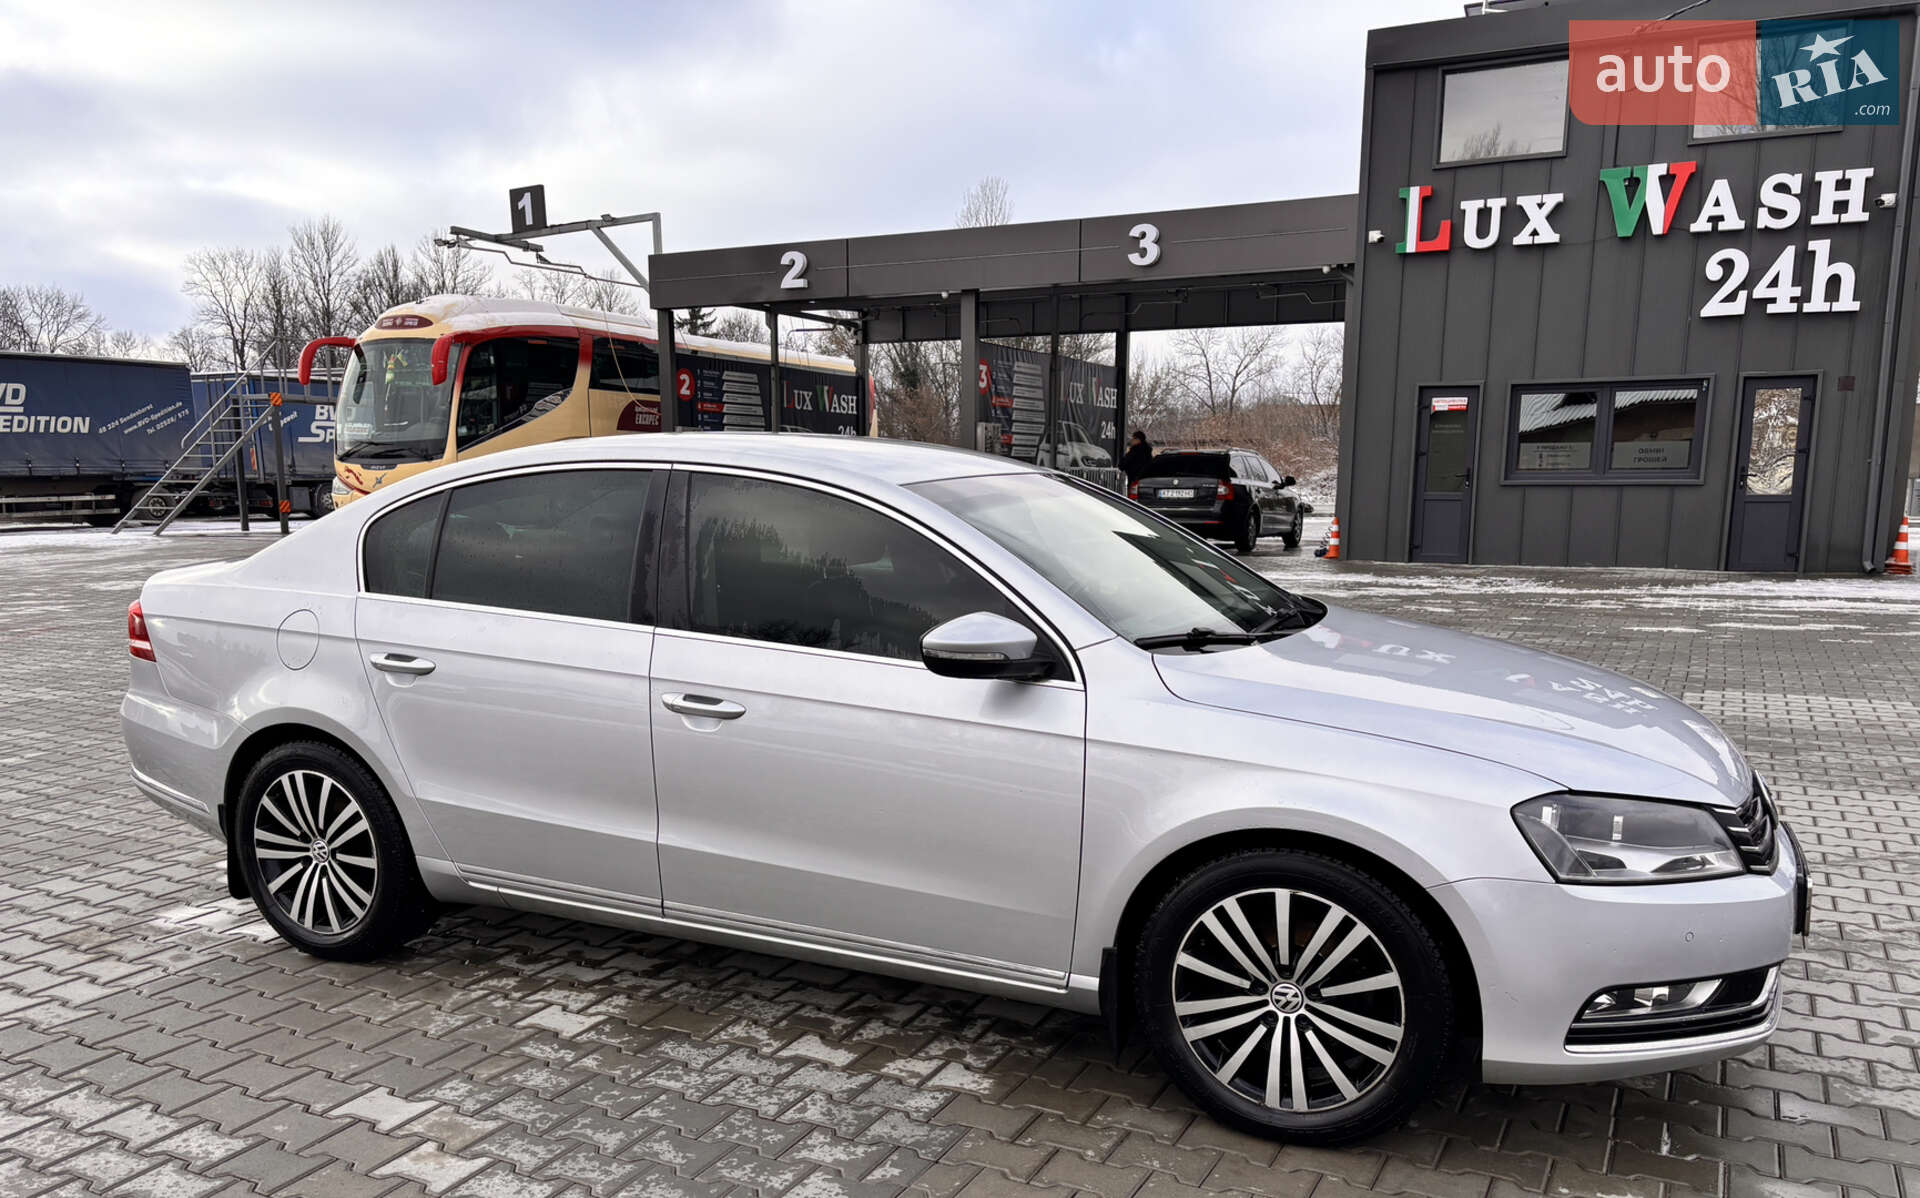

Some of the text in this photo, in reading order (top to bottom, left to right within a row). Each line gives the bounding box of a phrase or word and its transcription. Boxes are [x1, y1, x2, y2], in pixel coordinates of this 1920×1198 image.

[517, 192, 534, 226] 1
[1395, 161, 1875, 254] LUX WASH
[1127, 223, 1160, 266] 3
[780, 250, 808, 290] 2
[1700, 239, 1861, 318] 24h
[679, 373, 691, 396] 2
[978, 364, 988, 388] 3
[1088, 377, 1118, 409] WASH
[783, 380, 858, 415] LUX WASH
